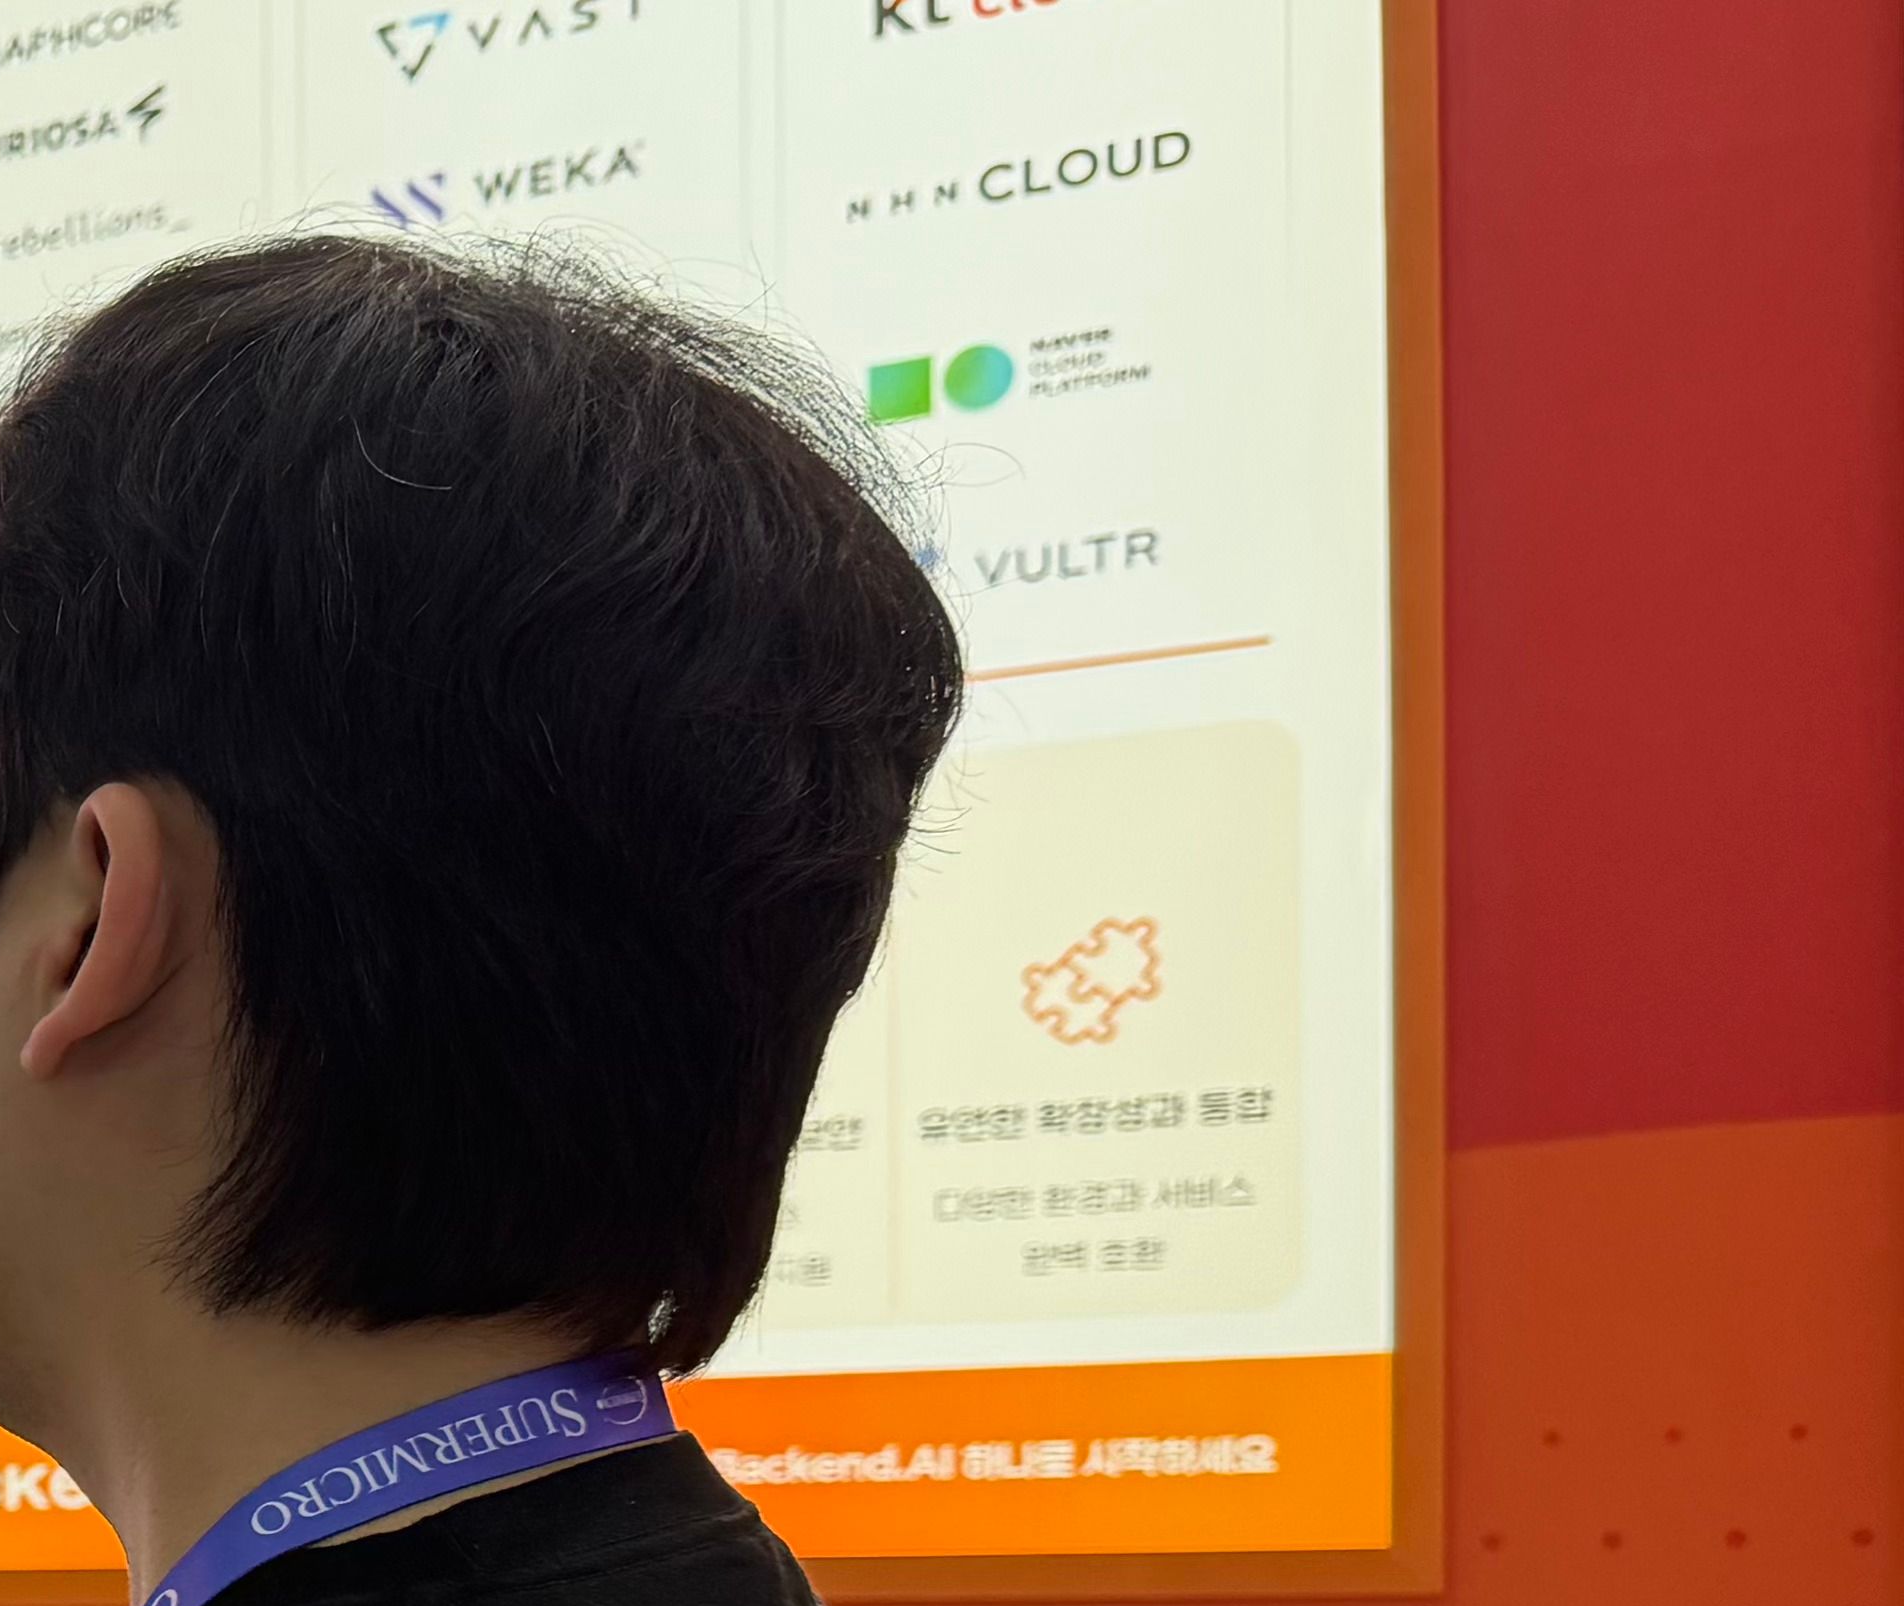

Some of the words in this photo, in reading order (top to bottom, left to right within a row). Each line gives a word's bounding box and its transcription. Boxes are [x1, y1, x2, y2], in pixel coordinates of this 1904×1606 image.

[474, 144, 641, 206] WEKA
[979, 131, 1191, 202] CLOUD
[1028, 352, 1105, 377] CLOUD
[1029, 365, 1152, 398] PLATFORM
[974, 526, 1160, 586] VULTR
[917, 1101, 1027, 1143] 유연한
[1037, 1090, 1187, 1136] 확장성과
[1197, 1081, 1274, 1127] 통합
[931, 1183, 1037, 1224] 다양한
[1040, 1178, 1145, 1219] 환경과
[1150, 1172, 1257, 1209] 서비스
[250, 1387, 588, 1537] SUPERMICRO
[711, 1443, 957, 1485] Backend.AI
[960, 1439, 1077, 1482] 하나로
[1080, 1434, 1278, 1477] 시작하세요
